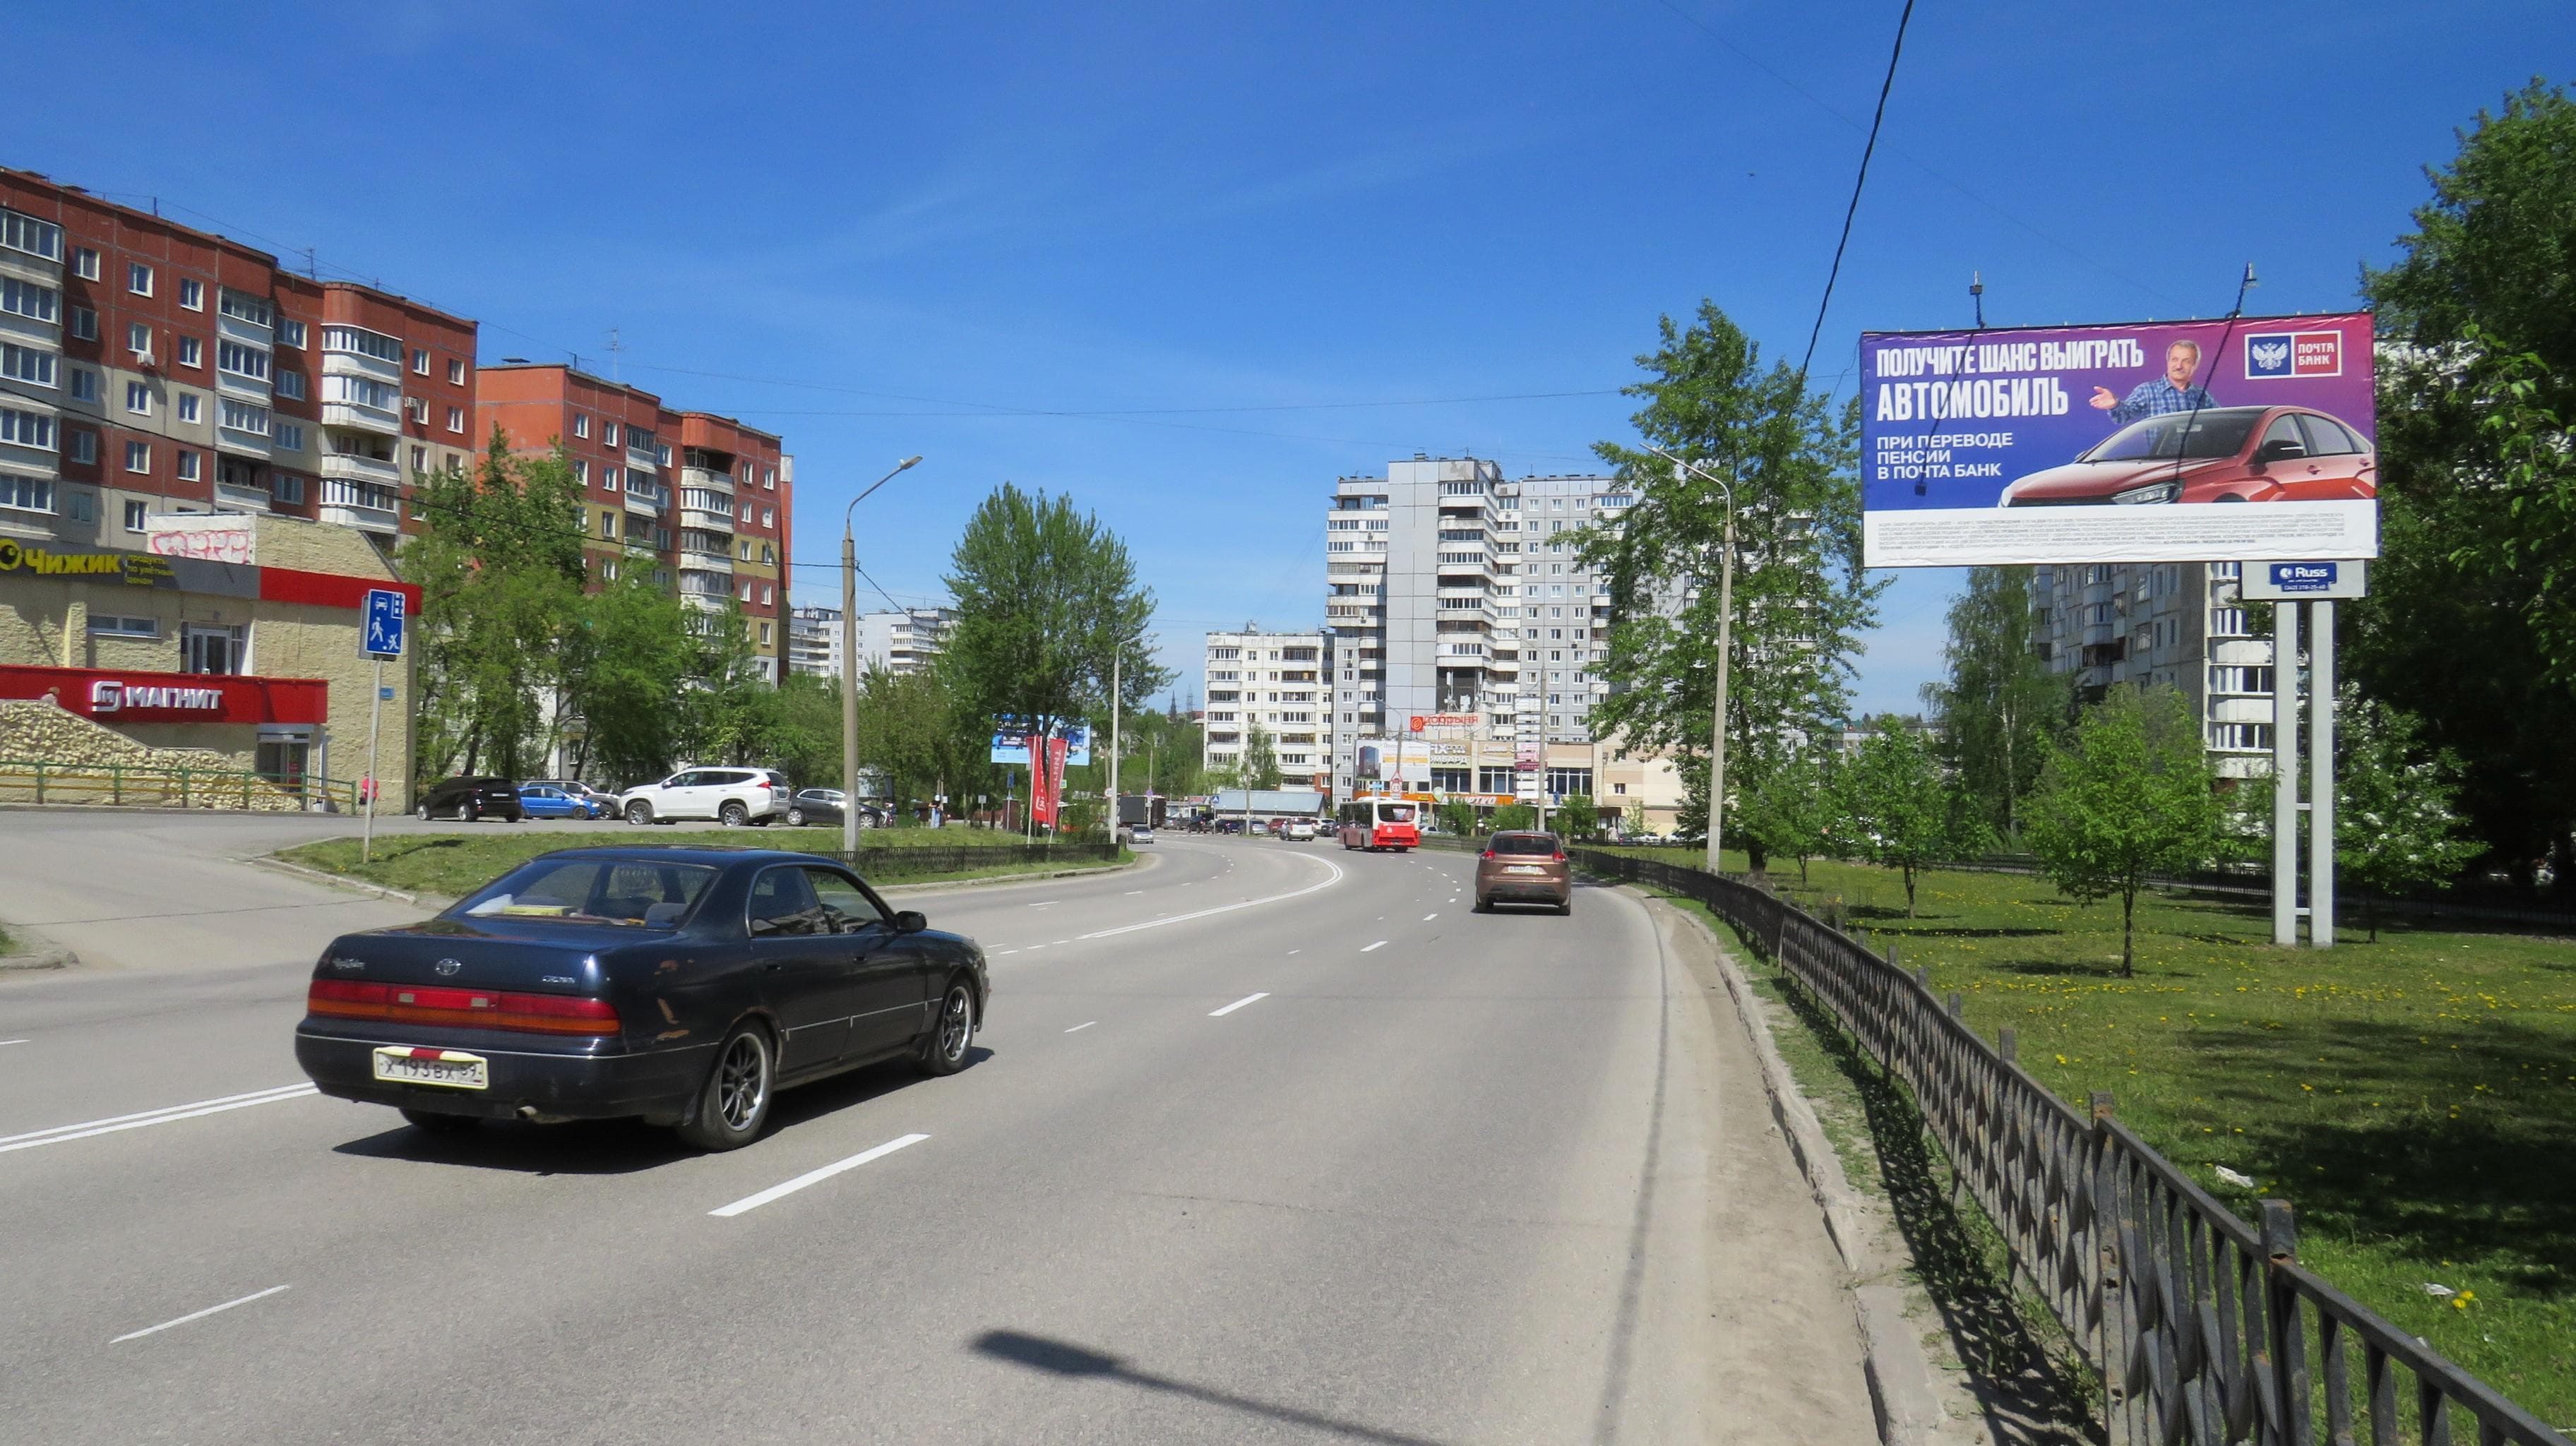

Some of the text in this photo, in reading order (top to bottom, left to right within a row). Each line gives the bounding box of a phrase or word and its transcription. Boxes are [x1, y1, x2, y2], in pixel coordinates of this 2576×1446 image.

[2298, 342, 2334, 354] ПОЧТА
[1876, 338, 2144, 377] ПОЛУЧИТЕ ШАНС ВЫИГРАТЬ
[2298, 354, 2330, 366] БАНК
[1876, 377, 2068, 421] АВТОМОБИЛЬ
[1877, 432, 2013, 450] ПРИ ПЕРЕВОДЕ
[1877, 450, 1951, 465] ПЕНСИИ
[1877, 463, 2002, 480] В ПОЧТА БАНК
[2295, 567, 2327, 578] Russ
[126, 686, 223, 710] МАГНИТ
